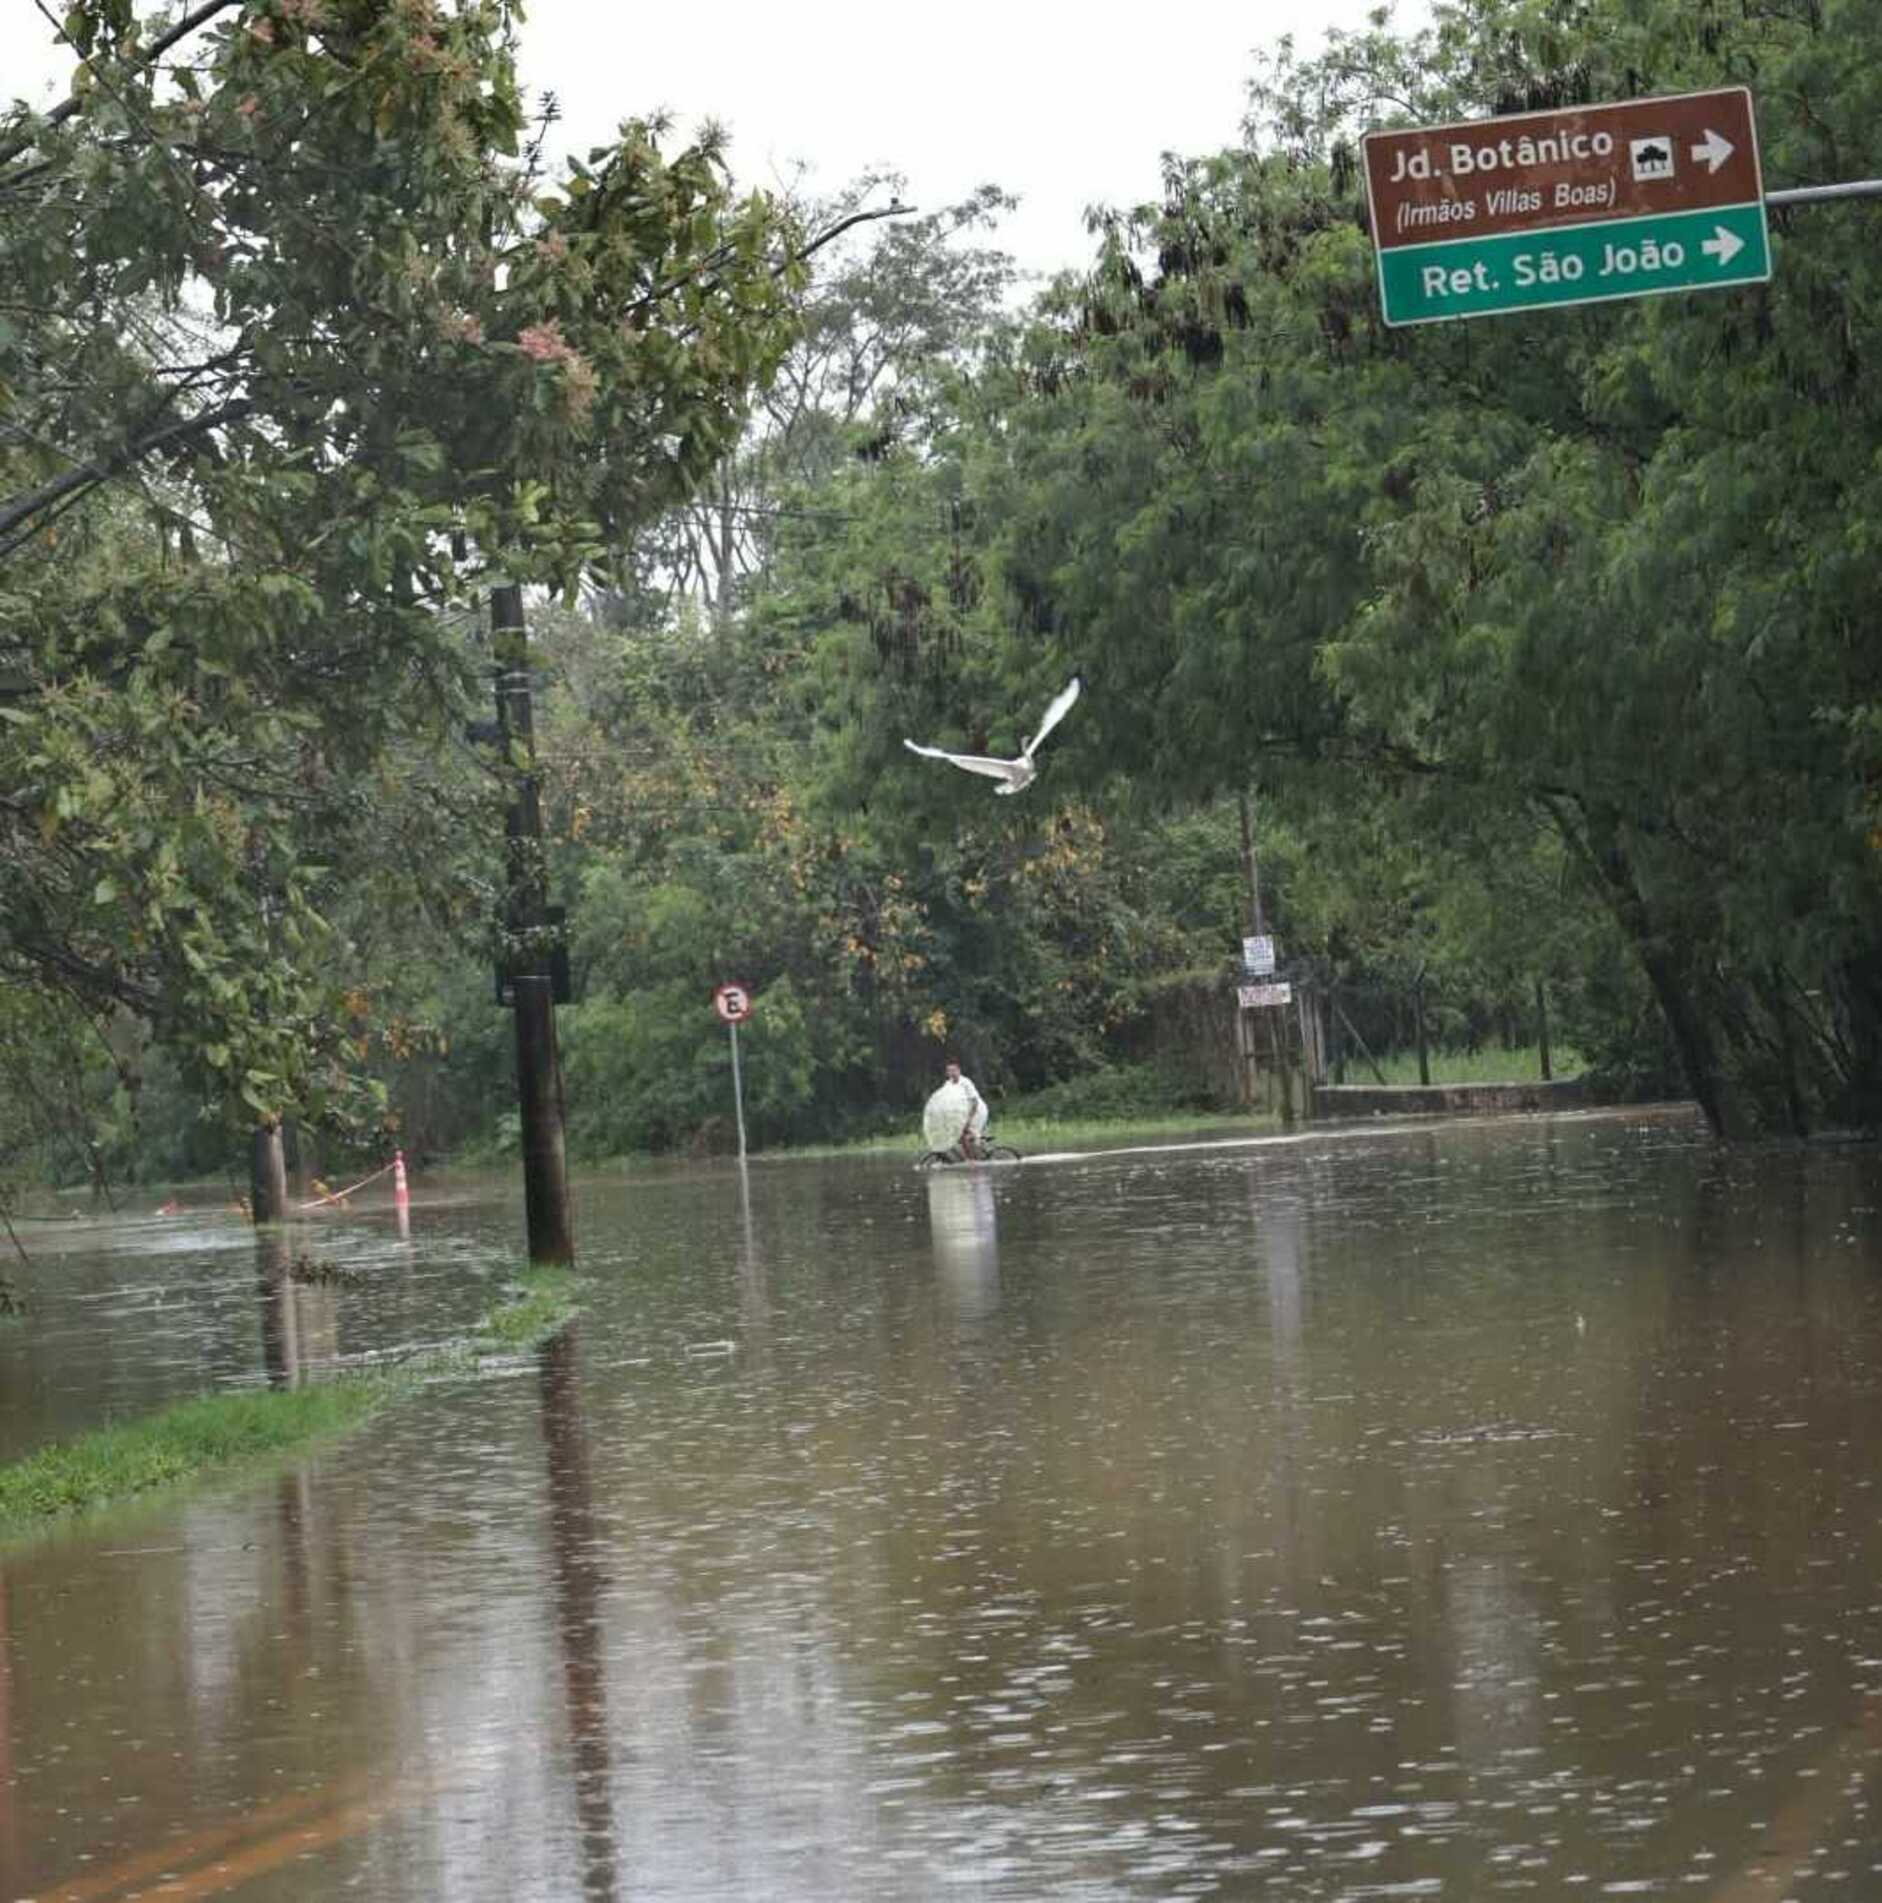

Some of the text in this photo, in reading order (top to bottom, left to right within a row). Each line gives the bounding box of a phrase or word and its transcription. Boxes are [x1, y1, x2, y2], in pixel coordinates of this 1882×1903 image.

[1390, 130, 1613, 182] Jd. Botânico
[1396, 176, 1617, 233] (Irmãos Villas Boas)
[1421, 239, 1685, 298] Ret. São João
[725, 992, 742, 1014] E
